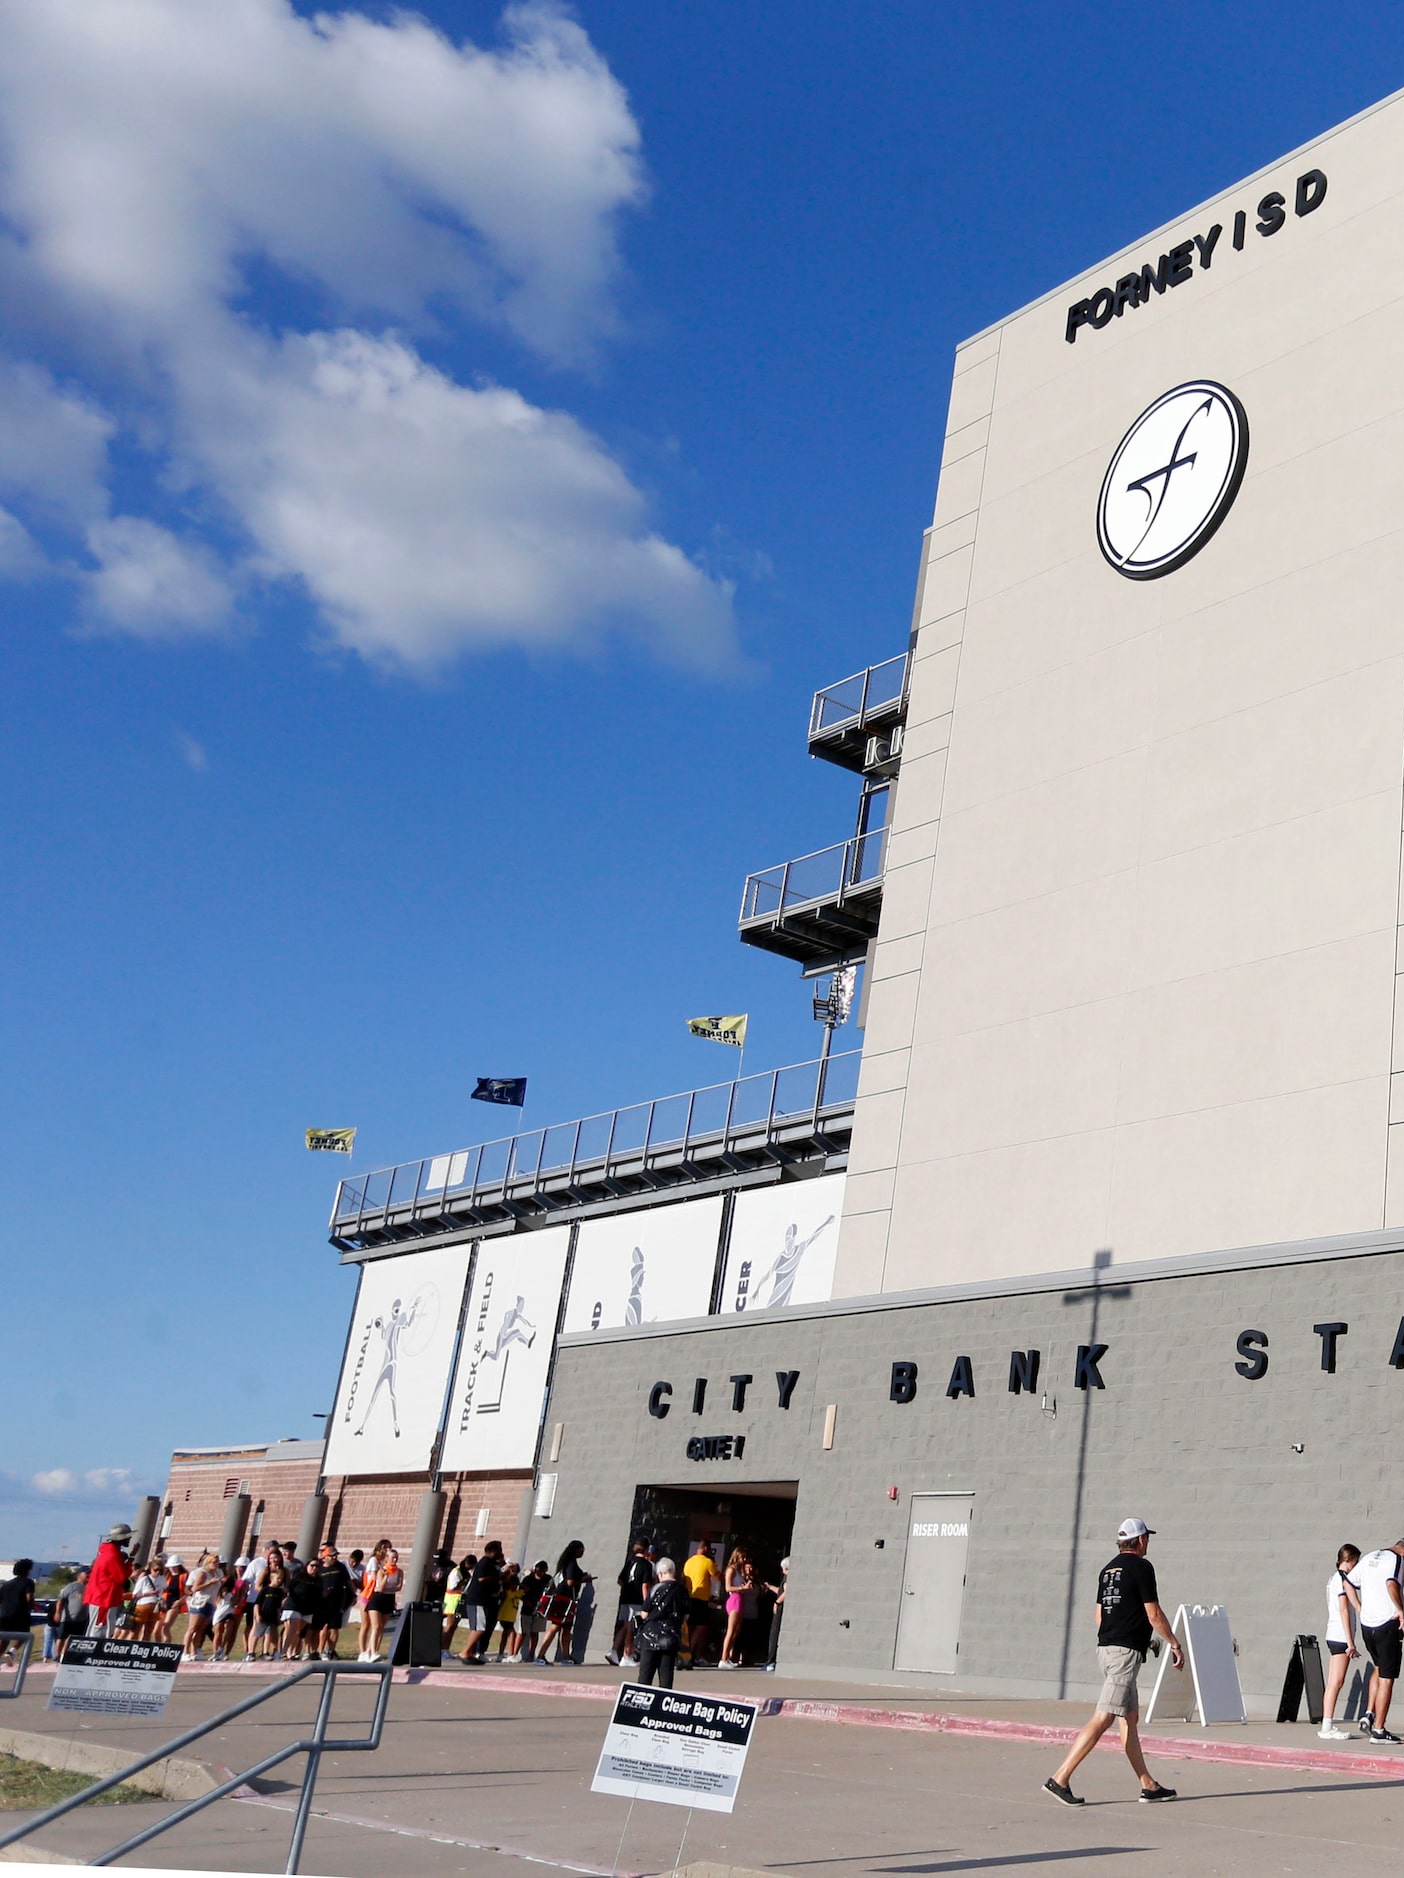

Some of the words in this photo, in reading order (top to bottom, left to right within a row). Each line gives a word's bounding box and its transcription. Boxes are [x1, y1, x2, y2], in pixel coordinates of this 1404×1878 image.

[1065, 223, 1223, 344] FORNEY
[477, 1271, 494, 1333] FIELD
[474, 1338, 483, 1353] &
[344, 1318, 374, 1423] FOOTBALL
[648, 1370, 801, 1420] CITY
[889, 1343, 1109, 1405] BANK
[459, 1361, 479, 1435] TRACK
[686, 1434, 733, 1462] GATE
[733, 1435, 746, 1460] 1
[912, 1523, 939, 1537] RISER
[940, 1523, 968, 1537] ROOM
[68, 1640, 97, 1650] FISD
[103, 1642, 128, 1654] Clear
[130, 1644, 149, 1659] Bag
[151, 1646, 181, 1661] Policy
[85, 1657, 131, 1668] Approved
[132, 1661, 157, 1670] Bags
[54, 1688, 77, 1696] NON
[85, 1689, 138, 1700] APPROVED
[140, 1694, 168, 1702] BAGS
[621, 1689, 656, 1706] FISD
[661, 1696, 690, 1714] Clear
[692, 1701, 715, 1722] Bag
[716, 1705, 751, 1729] Policy
[639, 1715, 693, 1733] Approved
[694, 1723, 723, 1739] Bags
